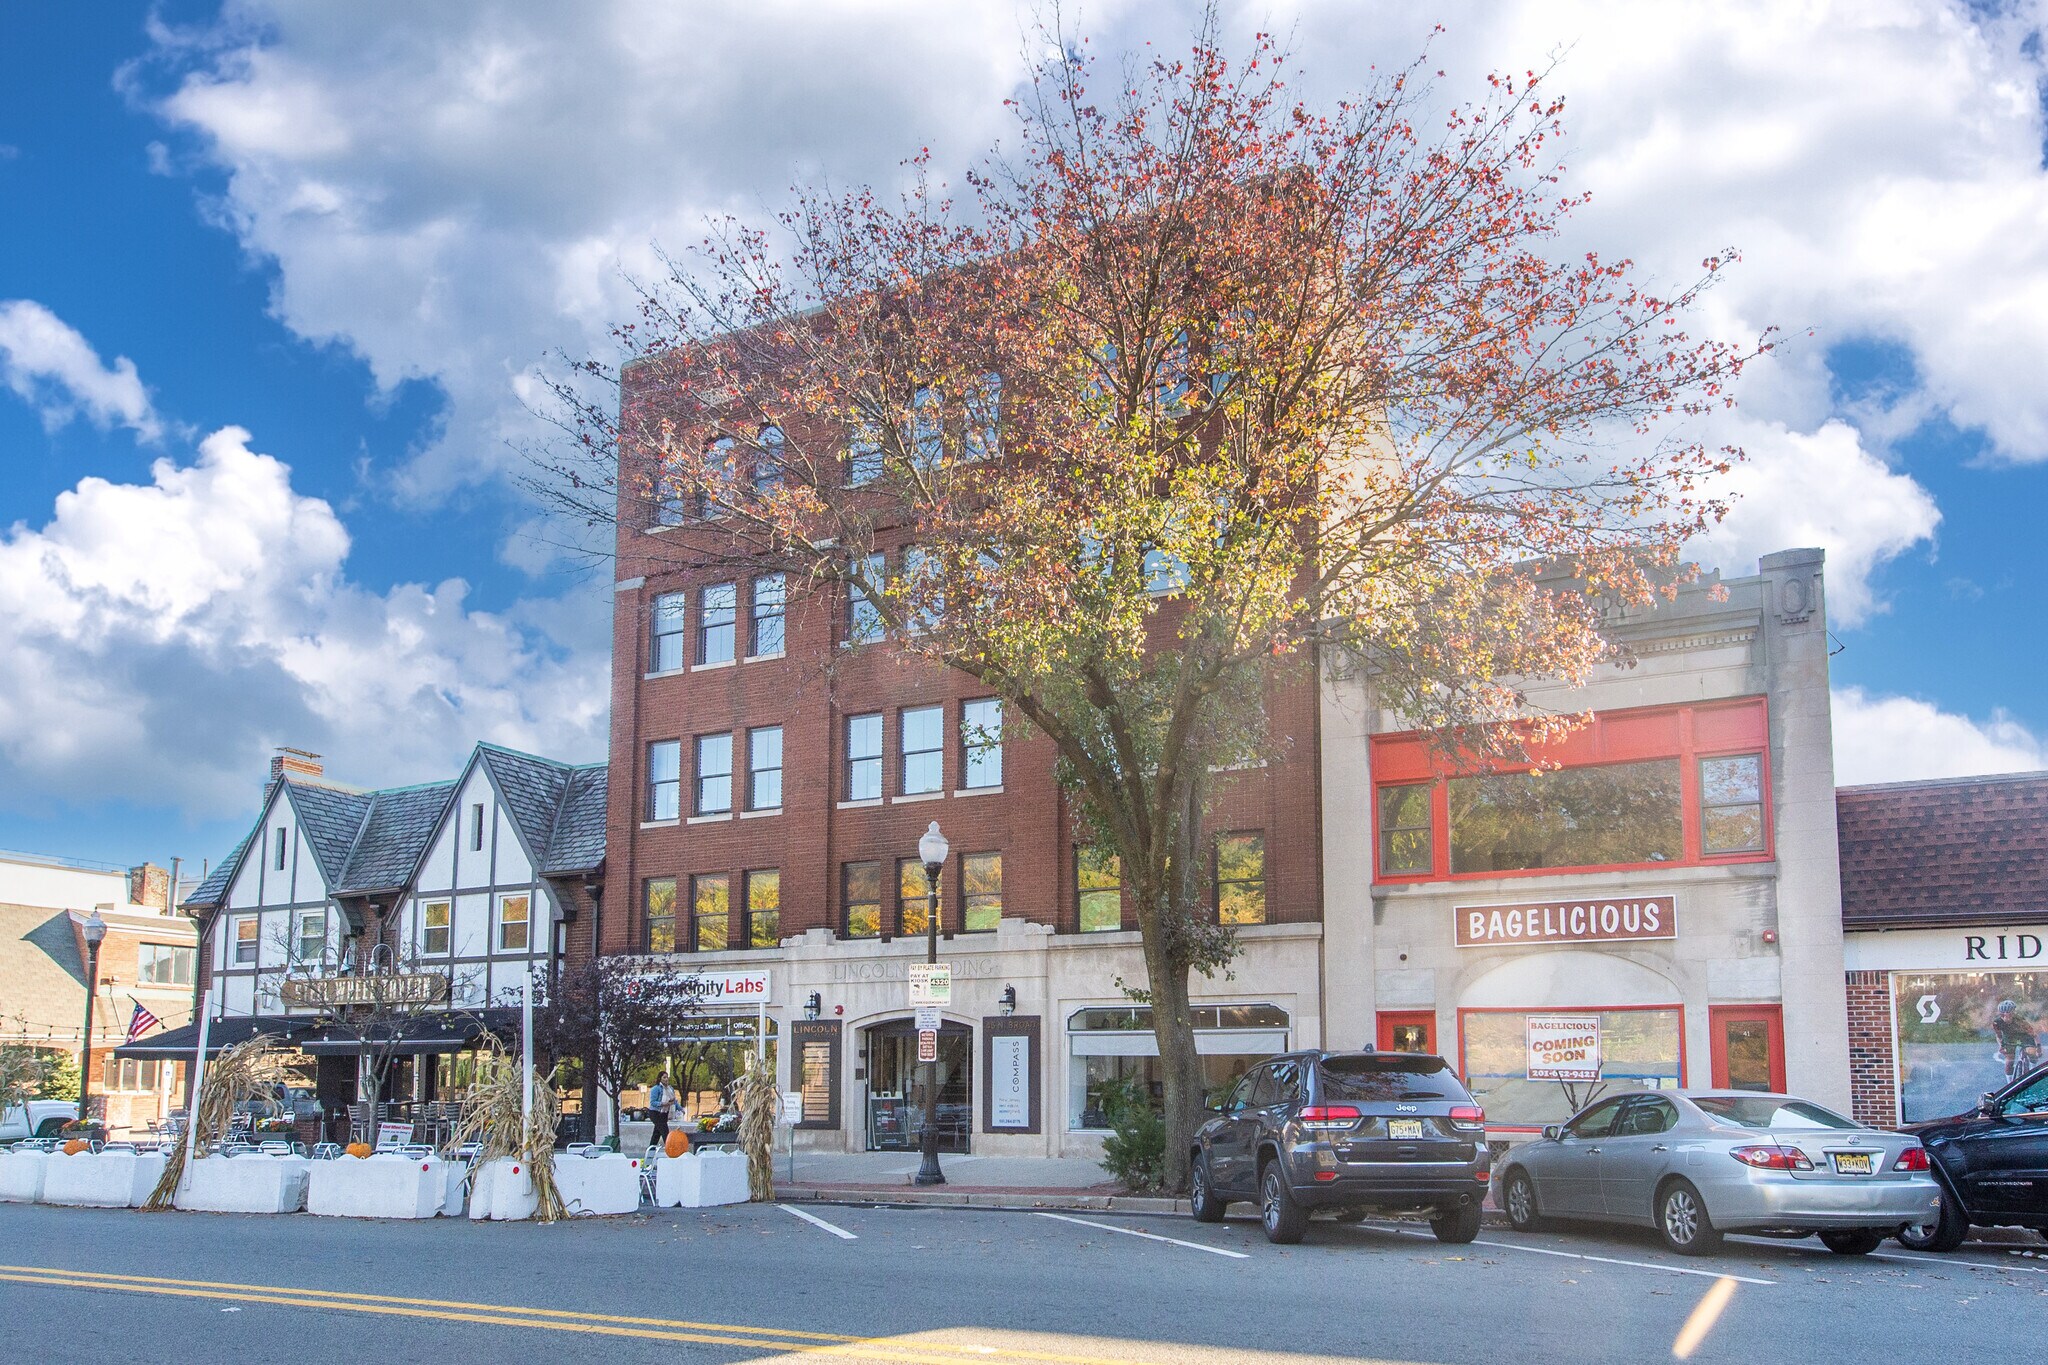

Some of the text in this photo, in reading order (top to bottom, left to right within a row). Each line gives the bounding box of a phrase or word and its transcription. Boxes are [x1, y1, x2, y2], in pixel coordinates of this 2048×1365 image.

[1469, 902, 1660, 940] BAGELICIOUS
[1964, 934, 2043, 960] RID
[834, 961, 906, 981] LINCOLN
[725, 978, 764, 994] Labs
[793, 1025, 838, 1034] LINCOLN
[1530, 1022, 1597, 1030] BAGELICIOUS
[1532, 1035, 1595, 1052] COMING
[1542, 1049, 1586, 1064] SOON
[1012, 1041, 1020, 1093] COMPASS
[1395, 1103, 1417, 1112] Jeep
